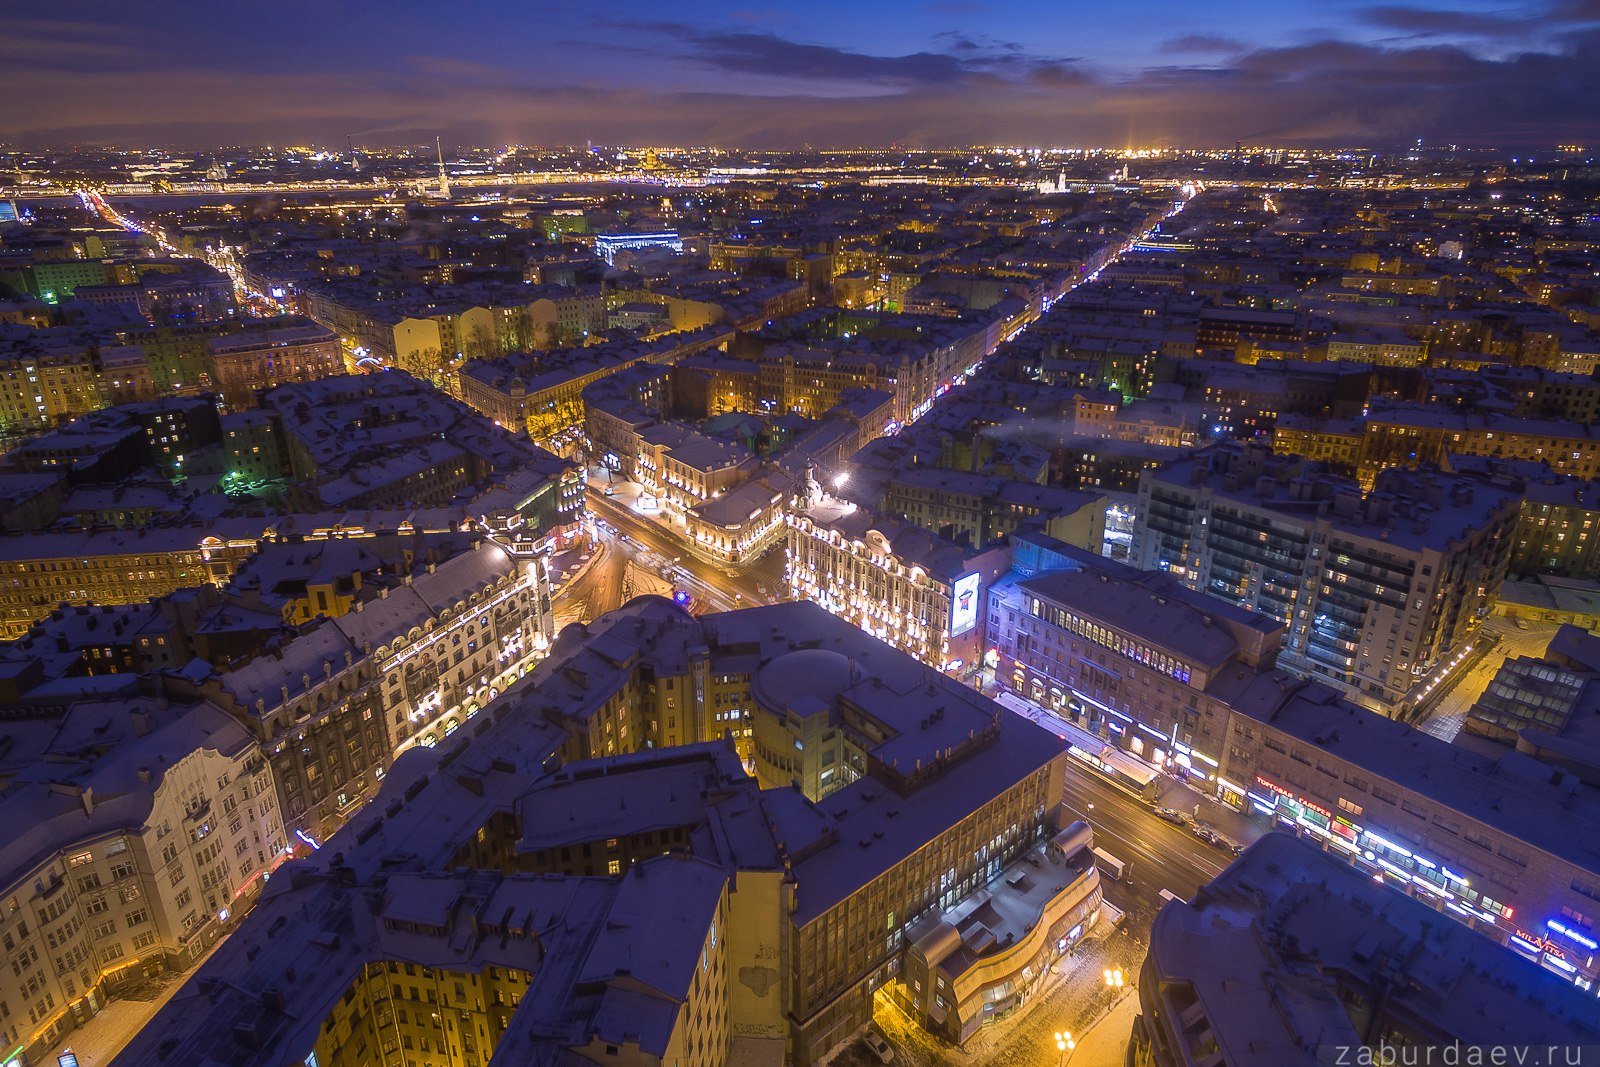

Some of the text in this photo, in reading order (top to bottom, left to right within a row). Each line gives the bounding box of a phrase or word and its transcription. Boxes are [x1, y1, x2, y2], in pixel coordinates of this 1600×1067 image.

[1256, 776, 1293, 798] ТОРГОВАЯ
[1299, 797, 1331, 817] ГАЛЕРЕЯ
[1515, 929, 1565, 960] MILAVITSA
